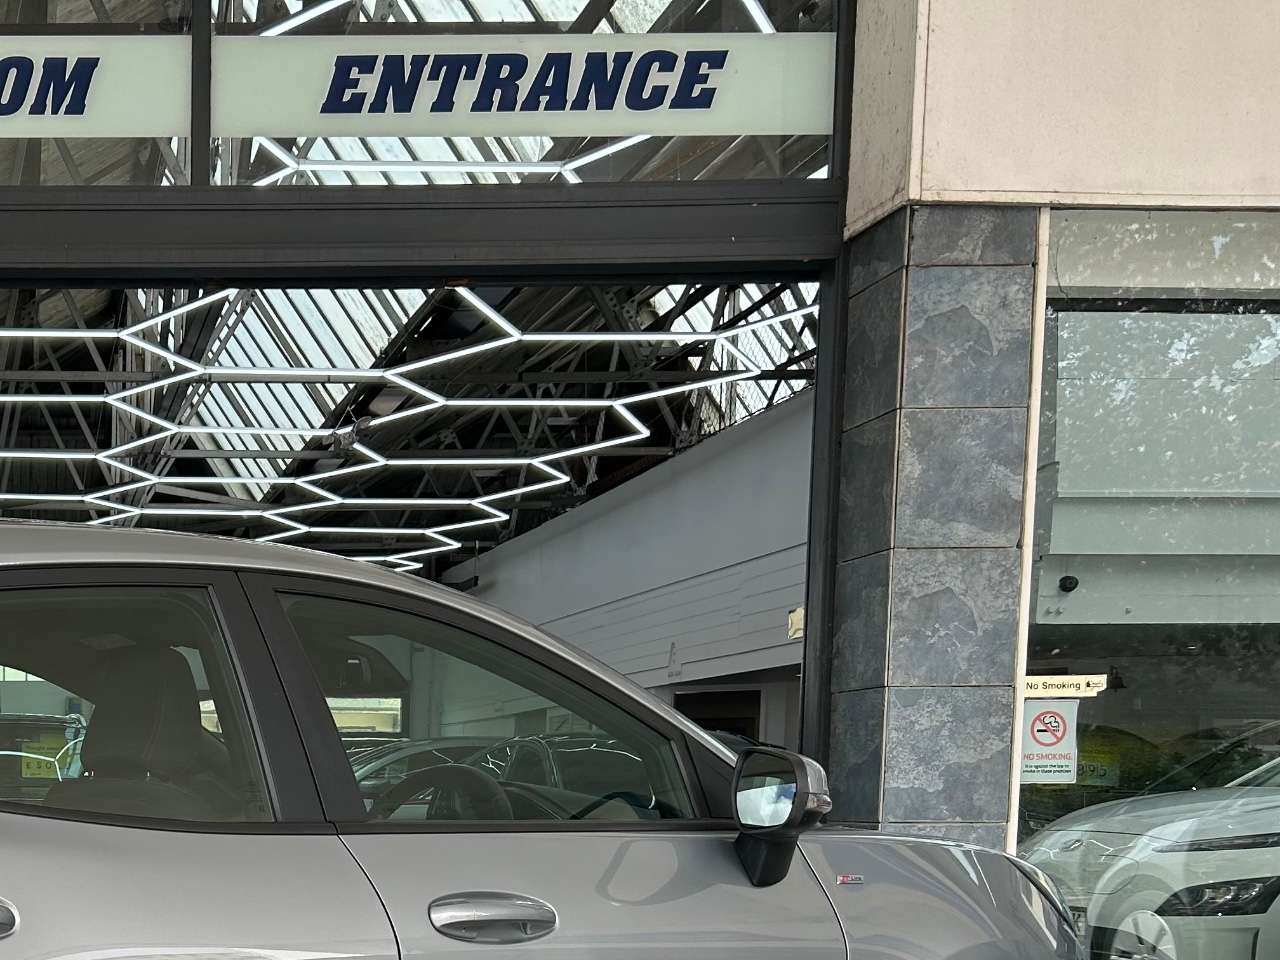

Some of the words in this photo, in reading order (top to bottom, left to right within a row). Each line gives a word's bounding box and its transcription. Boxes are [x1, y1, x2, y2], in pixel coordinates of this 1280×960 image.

[320, 49, 729, 114] ENTRANCE
[1025, 682, 1039, 690] No
[1042, 681, 1081, 691] Smoking
[1023, 752, 1035, 760] NO
